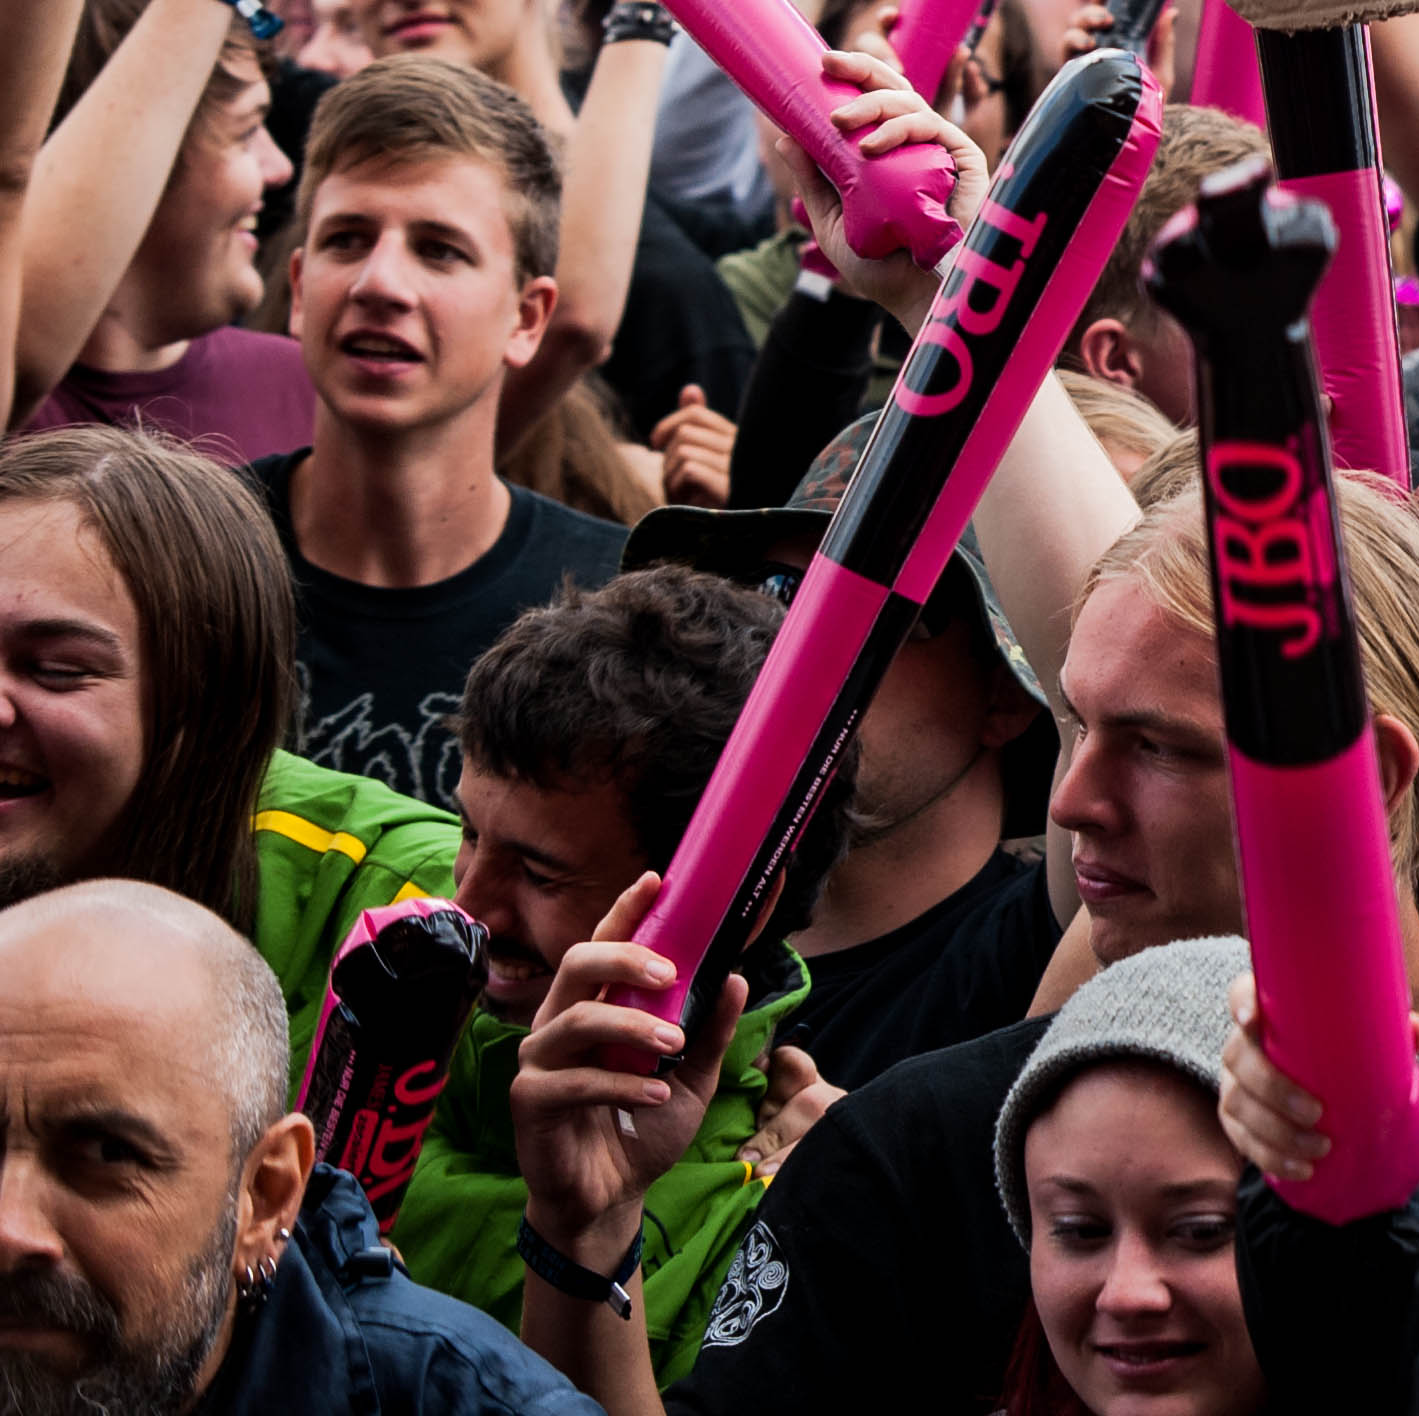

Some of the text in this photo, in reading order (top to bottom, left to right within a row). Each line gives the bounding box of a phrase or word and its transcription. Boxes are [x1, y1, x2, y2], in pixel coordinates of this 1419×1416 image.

[752, 727, 848, 900] NUR DIE BESTEN WERDEN ALT
